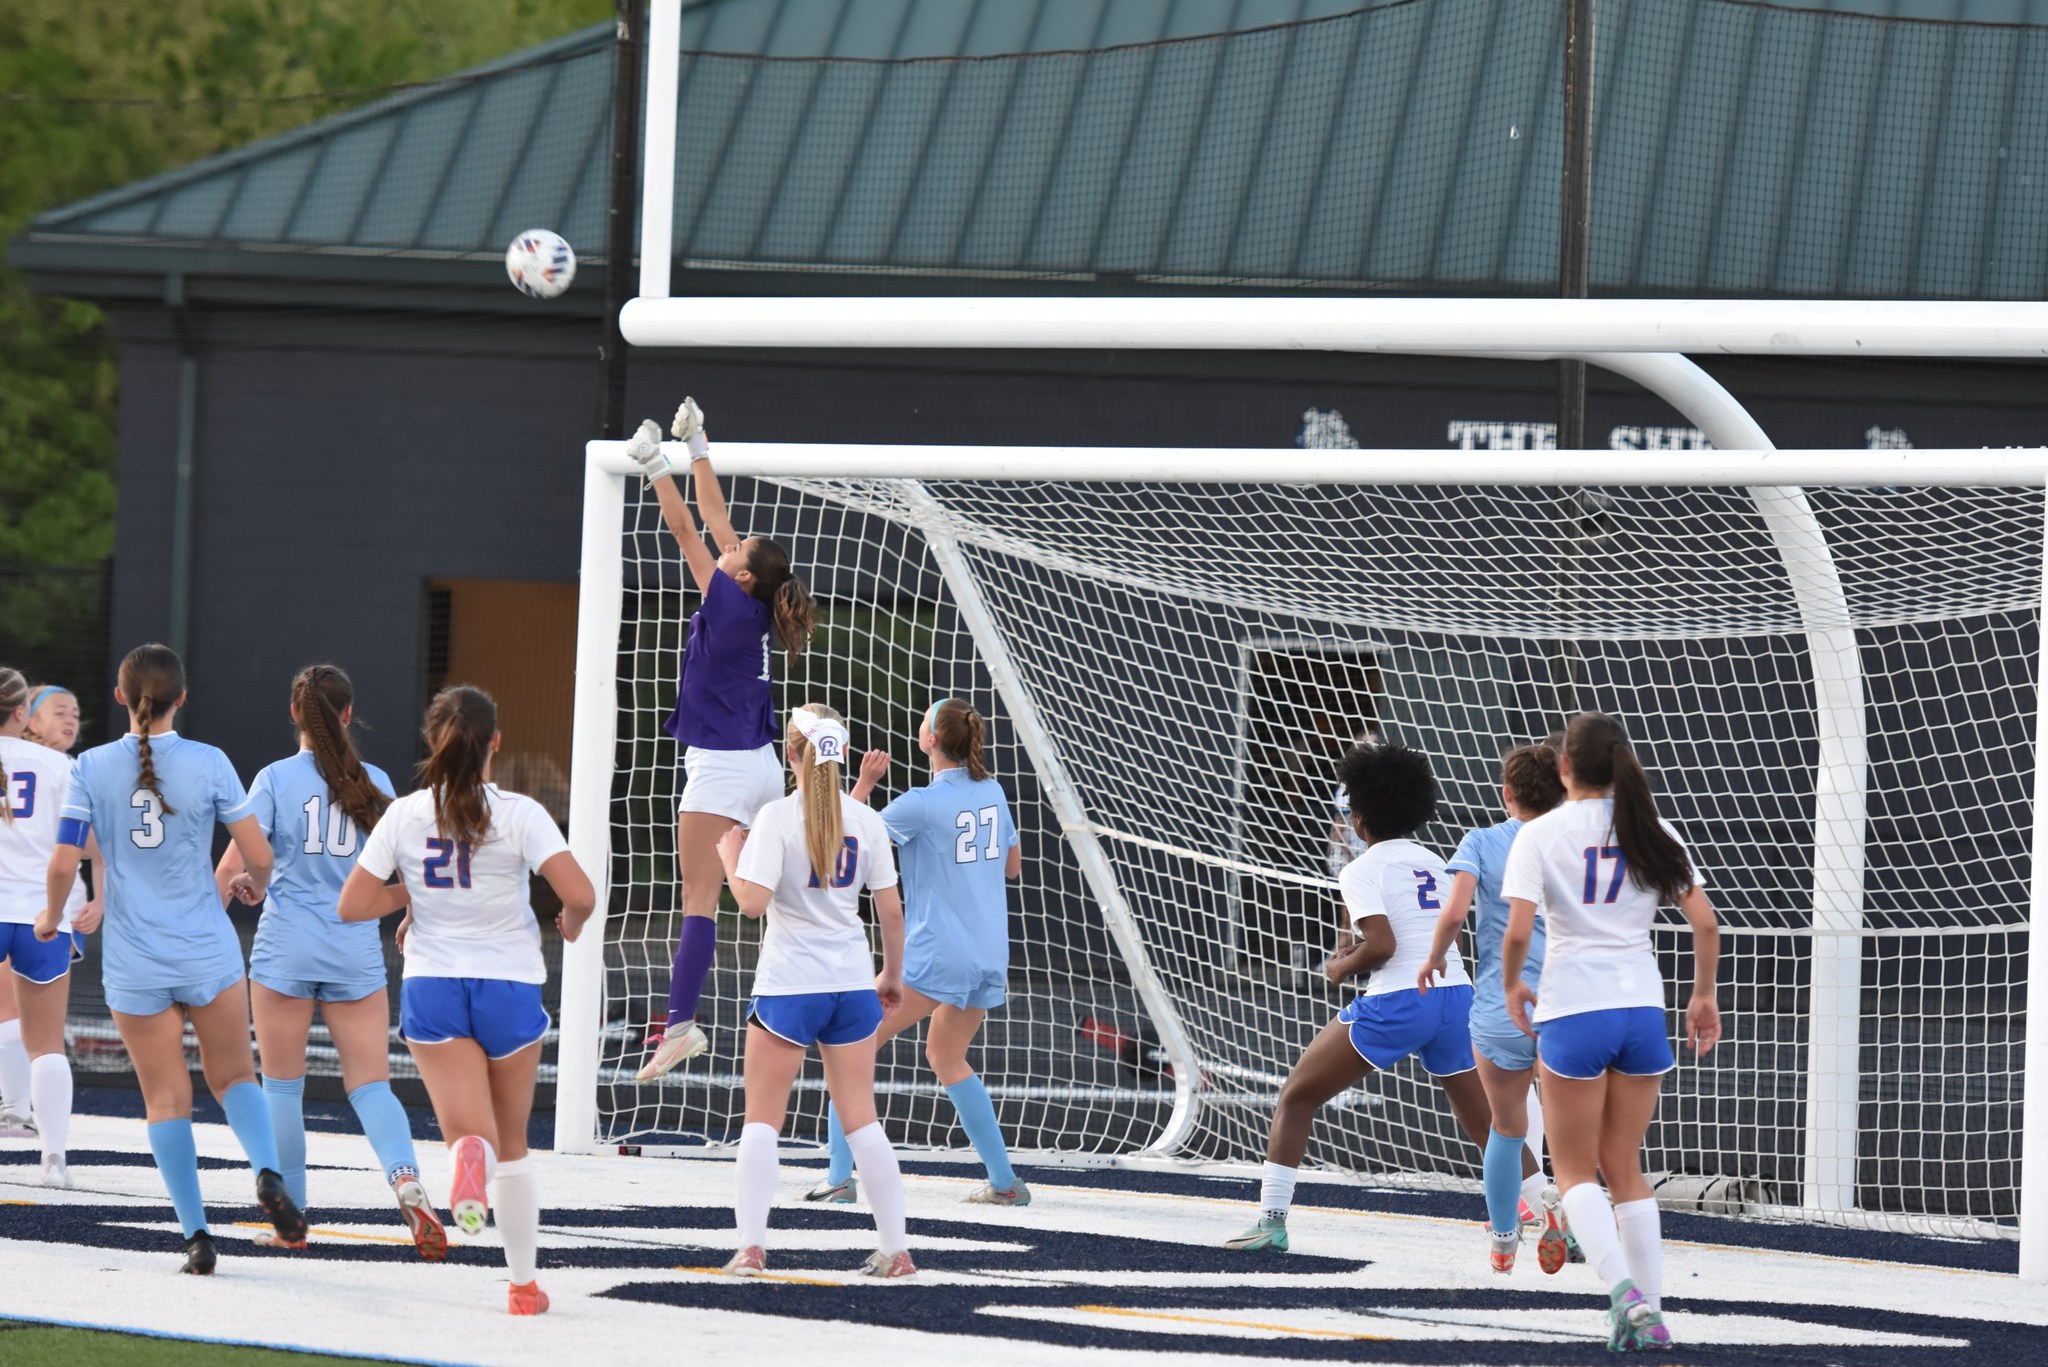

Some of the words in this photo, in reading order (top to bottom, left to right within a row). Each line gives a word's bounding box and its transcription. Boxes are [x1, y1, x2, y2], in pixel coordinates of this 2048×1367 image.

[0, 771, 36, 818] 3
[130, 788, 165, 849] 3
[303, 795, 357, 858] 10
[955, 804, 1000, 864] 27
[423, 837, 472, 889] 21
[1412, 869, 1441, 910] 2
[1583, 846, 1628, 904] 17
